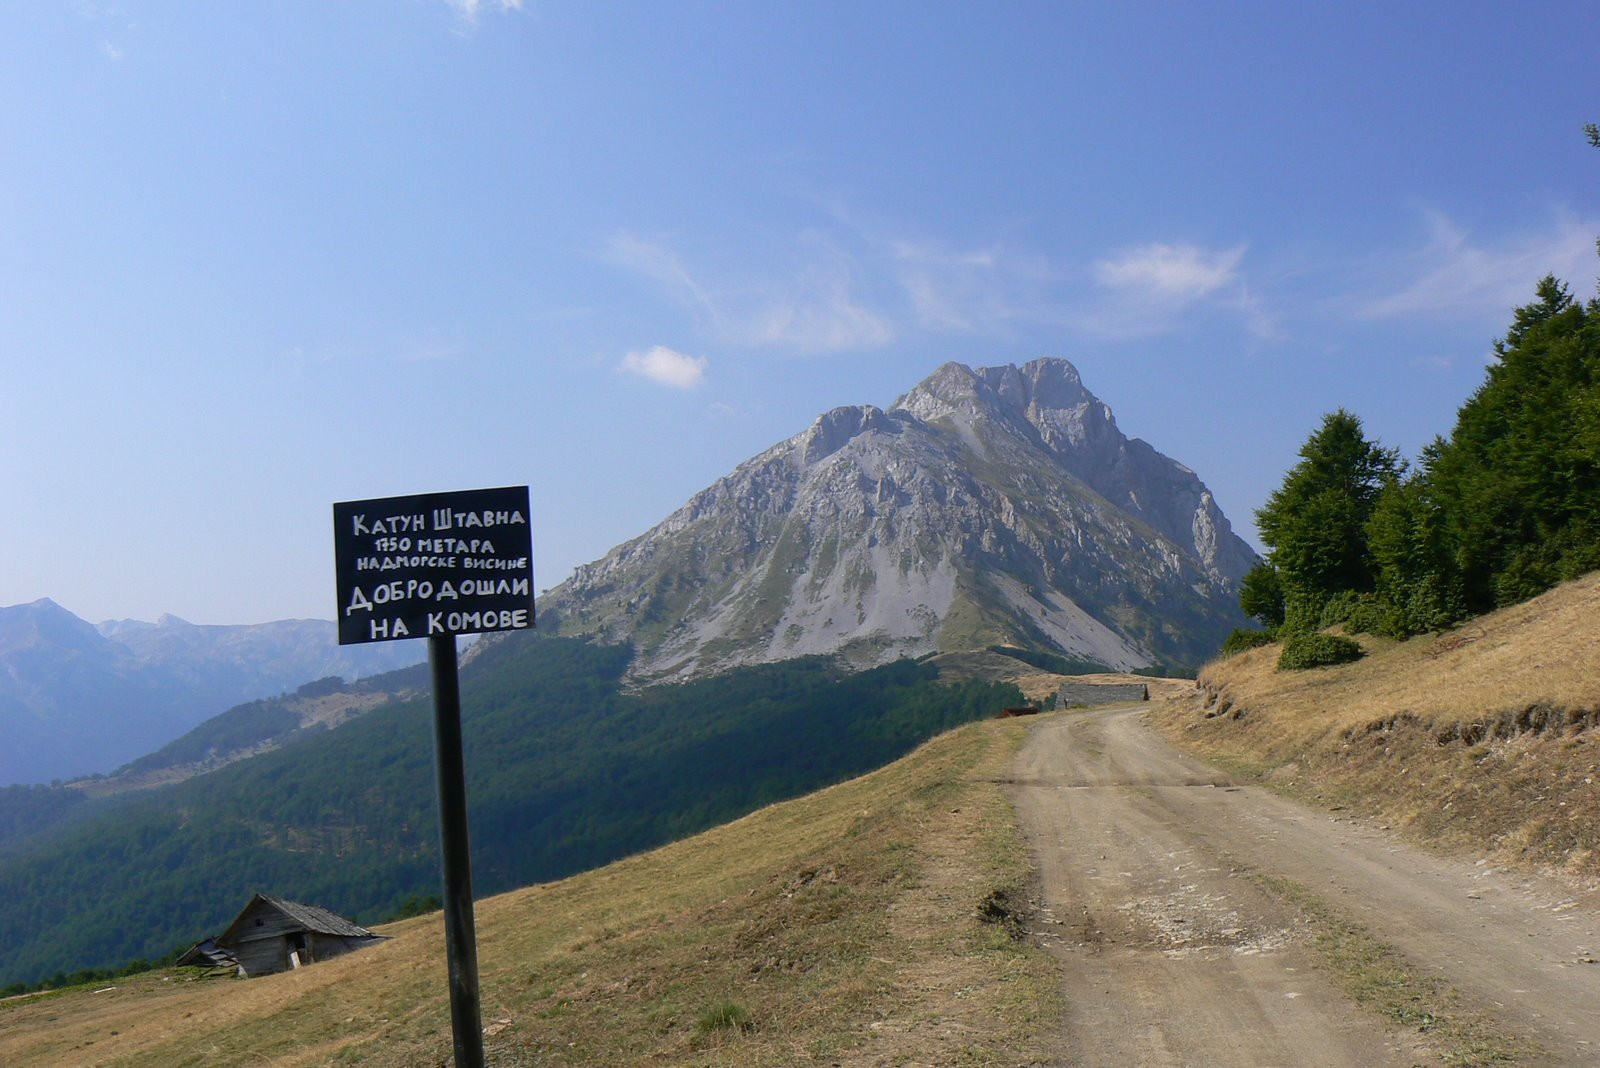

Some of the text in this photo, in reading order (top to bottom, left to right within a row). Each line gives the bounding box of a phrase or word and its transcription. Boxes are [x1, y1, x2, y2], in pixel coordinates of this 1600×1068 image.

[375, 537, 494, 553] 1750 МЕТАРА
[357, 556, 527, 572] НАДМОРСКЕ ВИСИНЕ
[370, 609, 528, 639] НА КОМОВЕ
